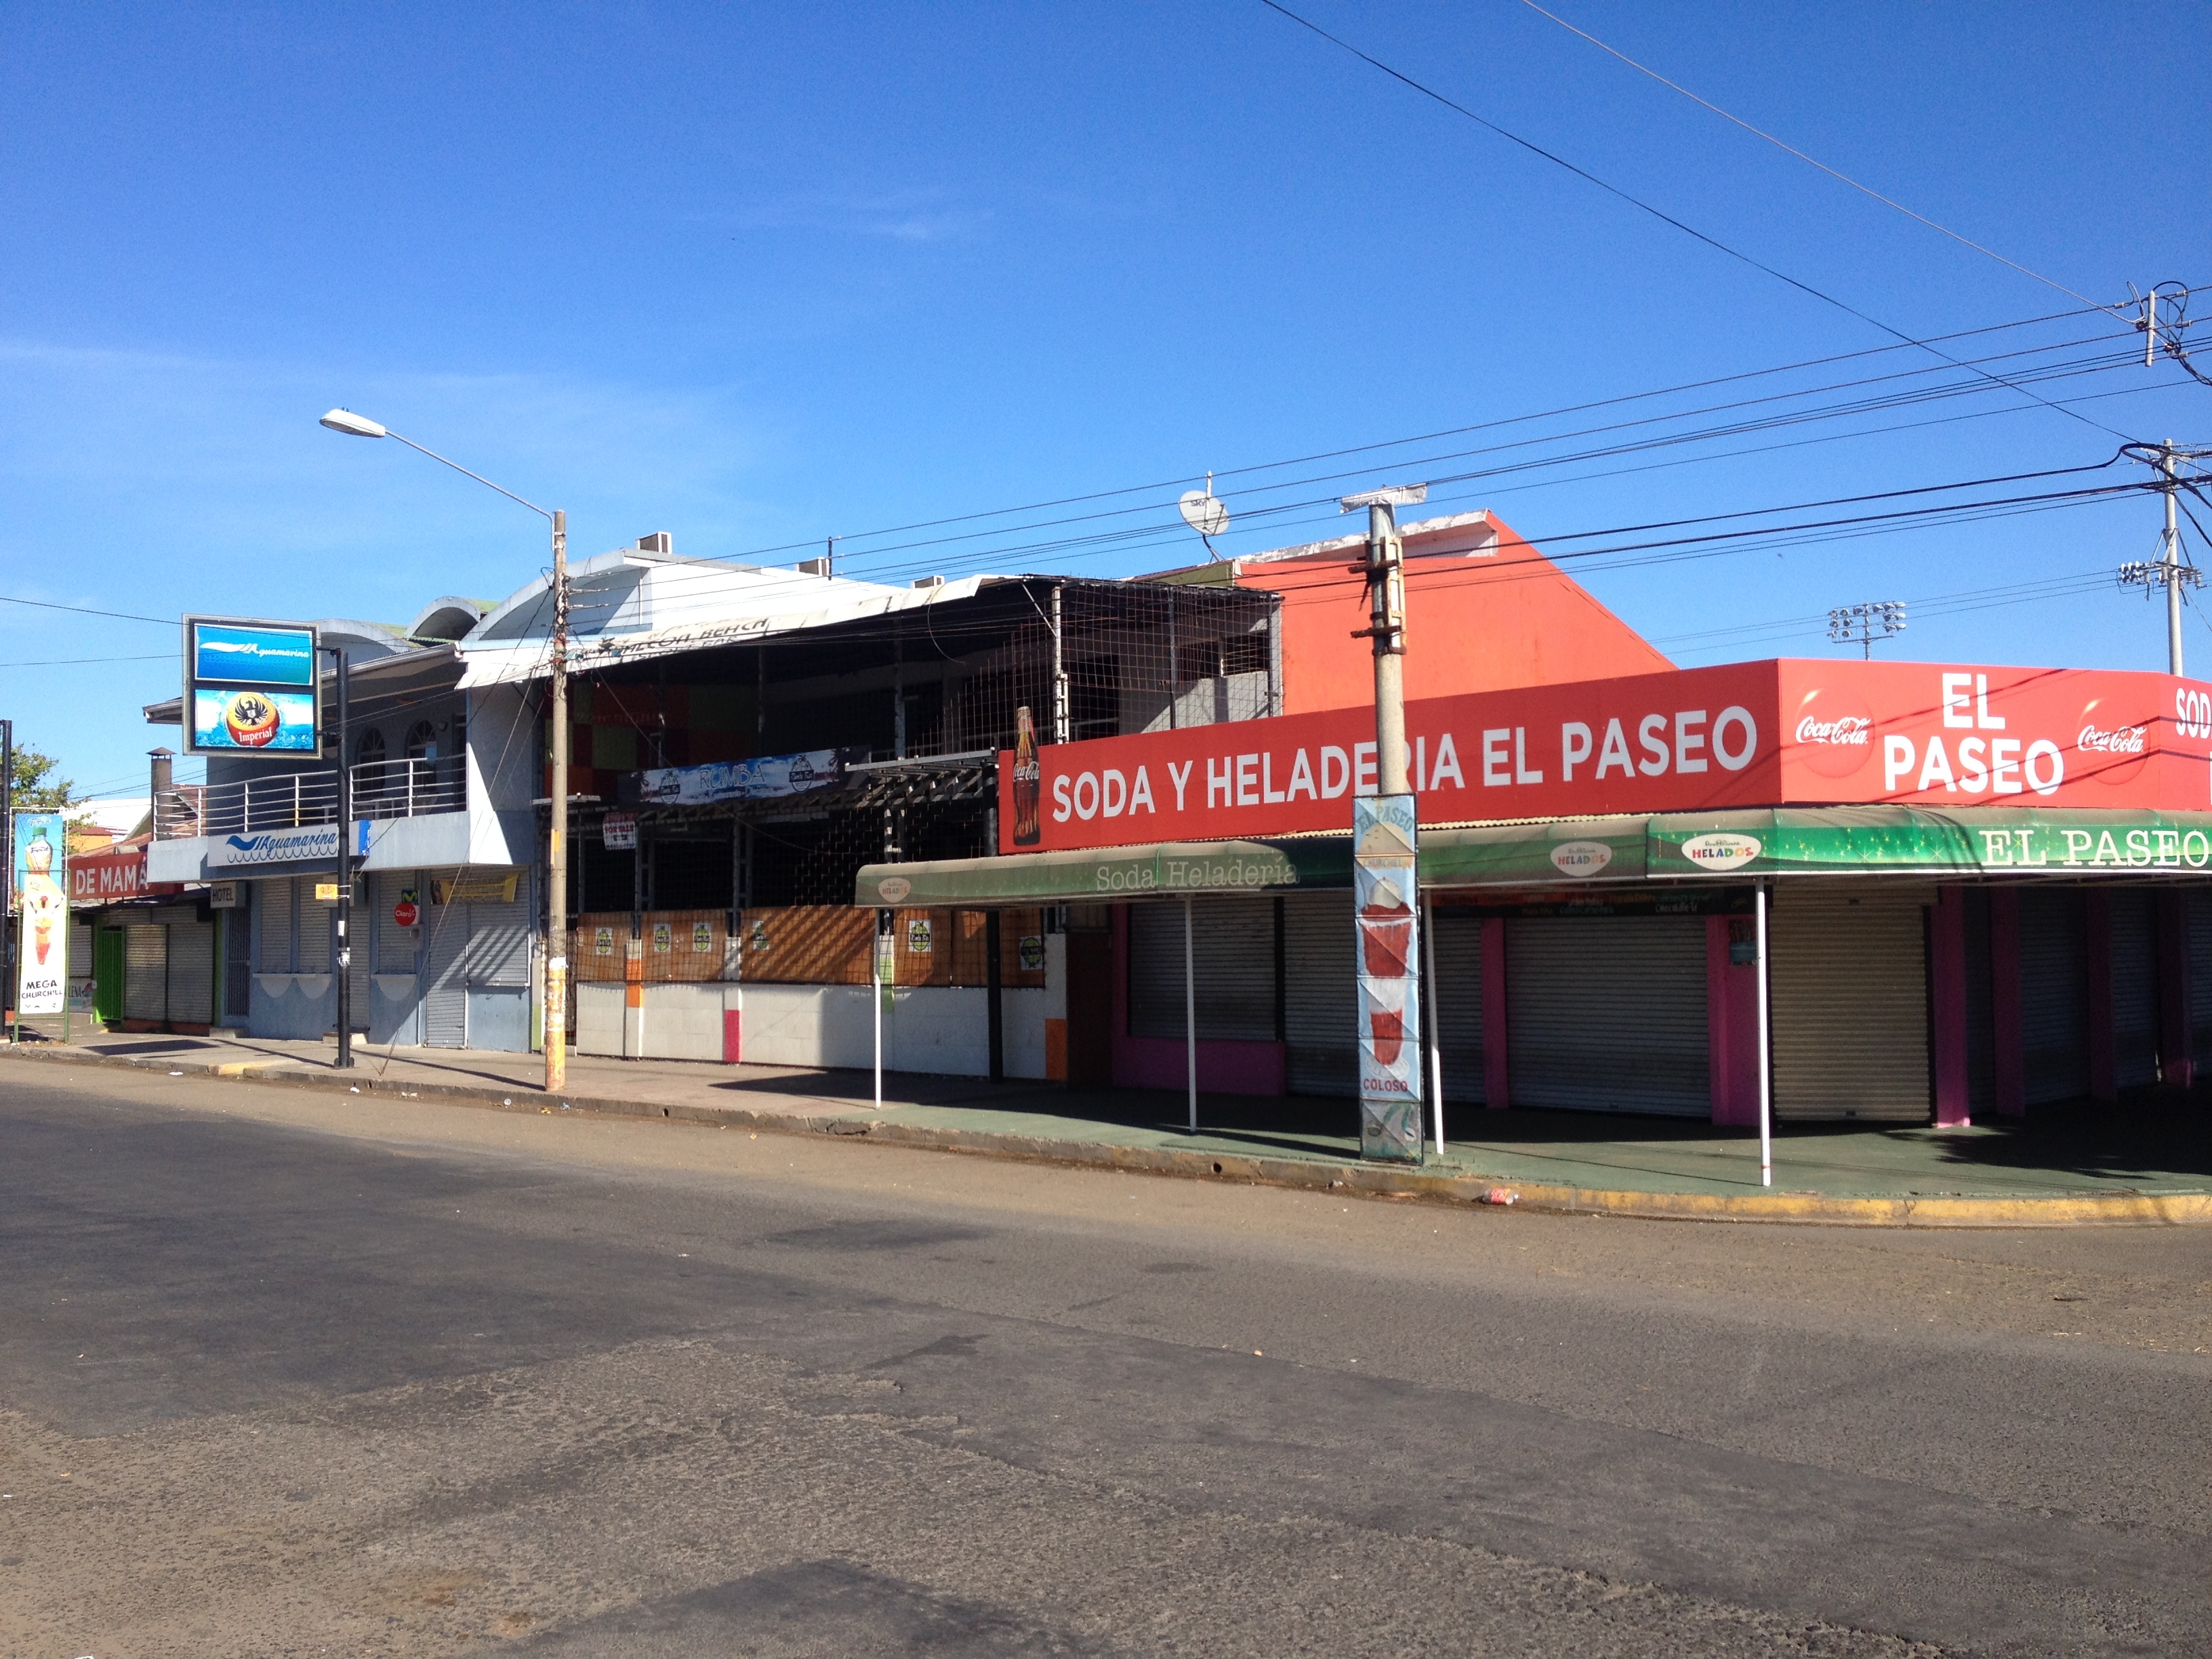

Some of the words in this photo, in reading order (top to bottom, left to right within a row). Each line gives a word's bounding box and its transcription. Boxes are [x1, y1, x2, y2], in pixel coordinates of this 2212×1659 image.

[1942, 672, 2006, 730] EL
[2175, 688, 2212, 739] SOD
[238, 726, 272, 745] Imperial
[1795, 716, 1872, 745] Coca-Cola
[2077, 724, 2148, 752] Coca-Cola
[699, 763, 766, 789] RUMBA
[1052, 766, 1155, 823] SODA
[1168, 760, 1193, 811] Y
[1207, 733, 1465, 808] HELADEIA
[1483, 726, 1543, 786] EL
[1562, 705, 1757, 781] PASEO
[1884, 735, 2064, 796] PASEO
[261, 828, 337, 857] Aguamarina
[1692, 846, 1754, 859] HELADOS
[1978, 830, 2048, 867] EL
[2055, 830, 2209, 867] PASEO
[1097, 865, 1157, 892] Soda
[1166, 855, 1300, 888] Heladería
[1558, 855, 1606, 865] HELADOS
[75, 868, 96, 895] DE
[212, 887, 234, 903] HOTEL
[395, 909, 412, 918] Claro
[21, 989, 63, 999] CHURCHILL
[26, 979, 58, 990] MEGA
[1363, 1078, 1408, 1092] COLOSO
